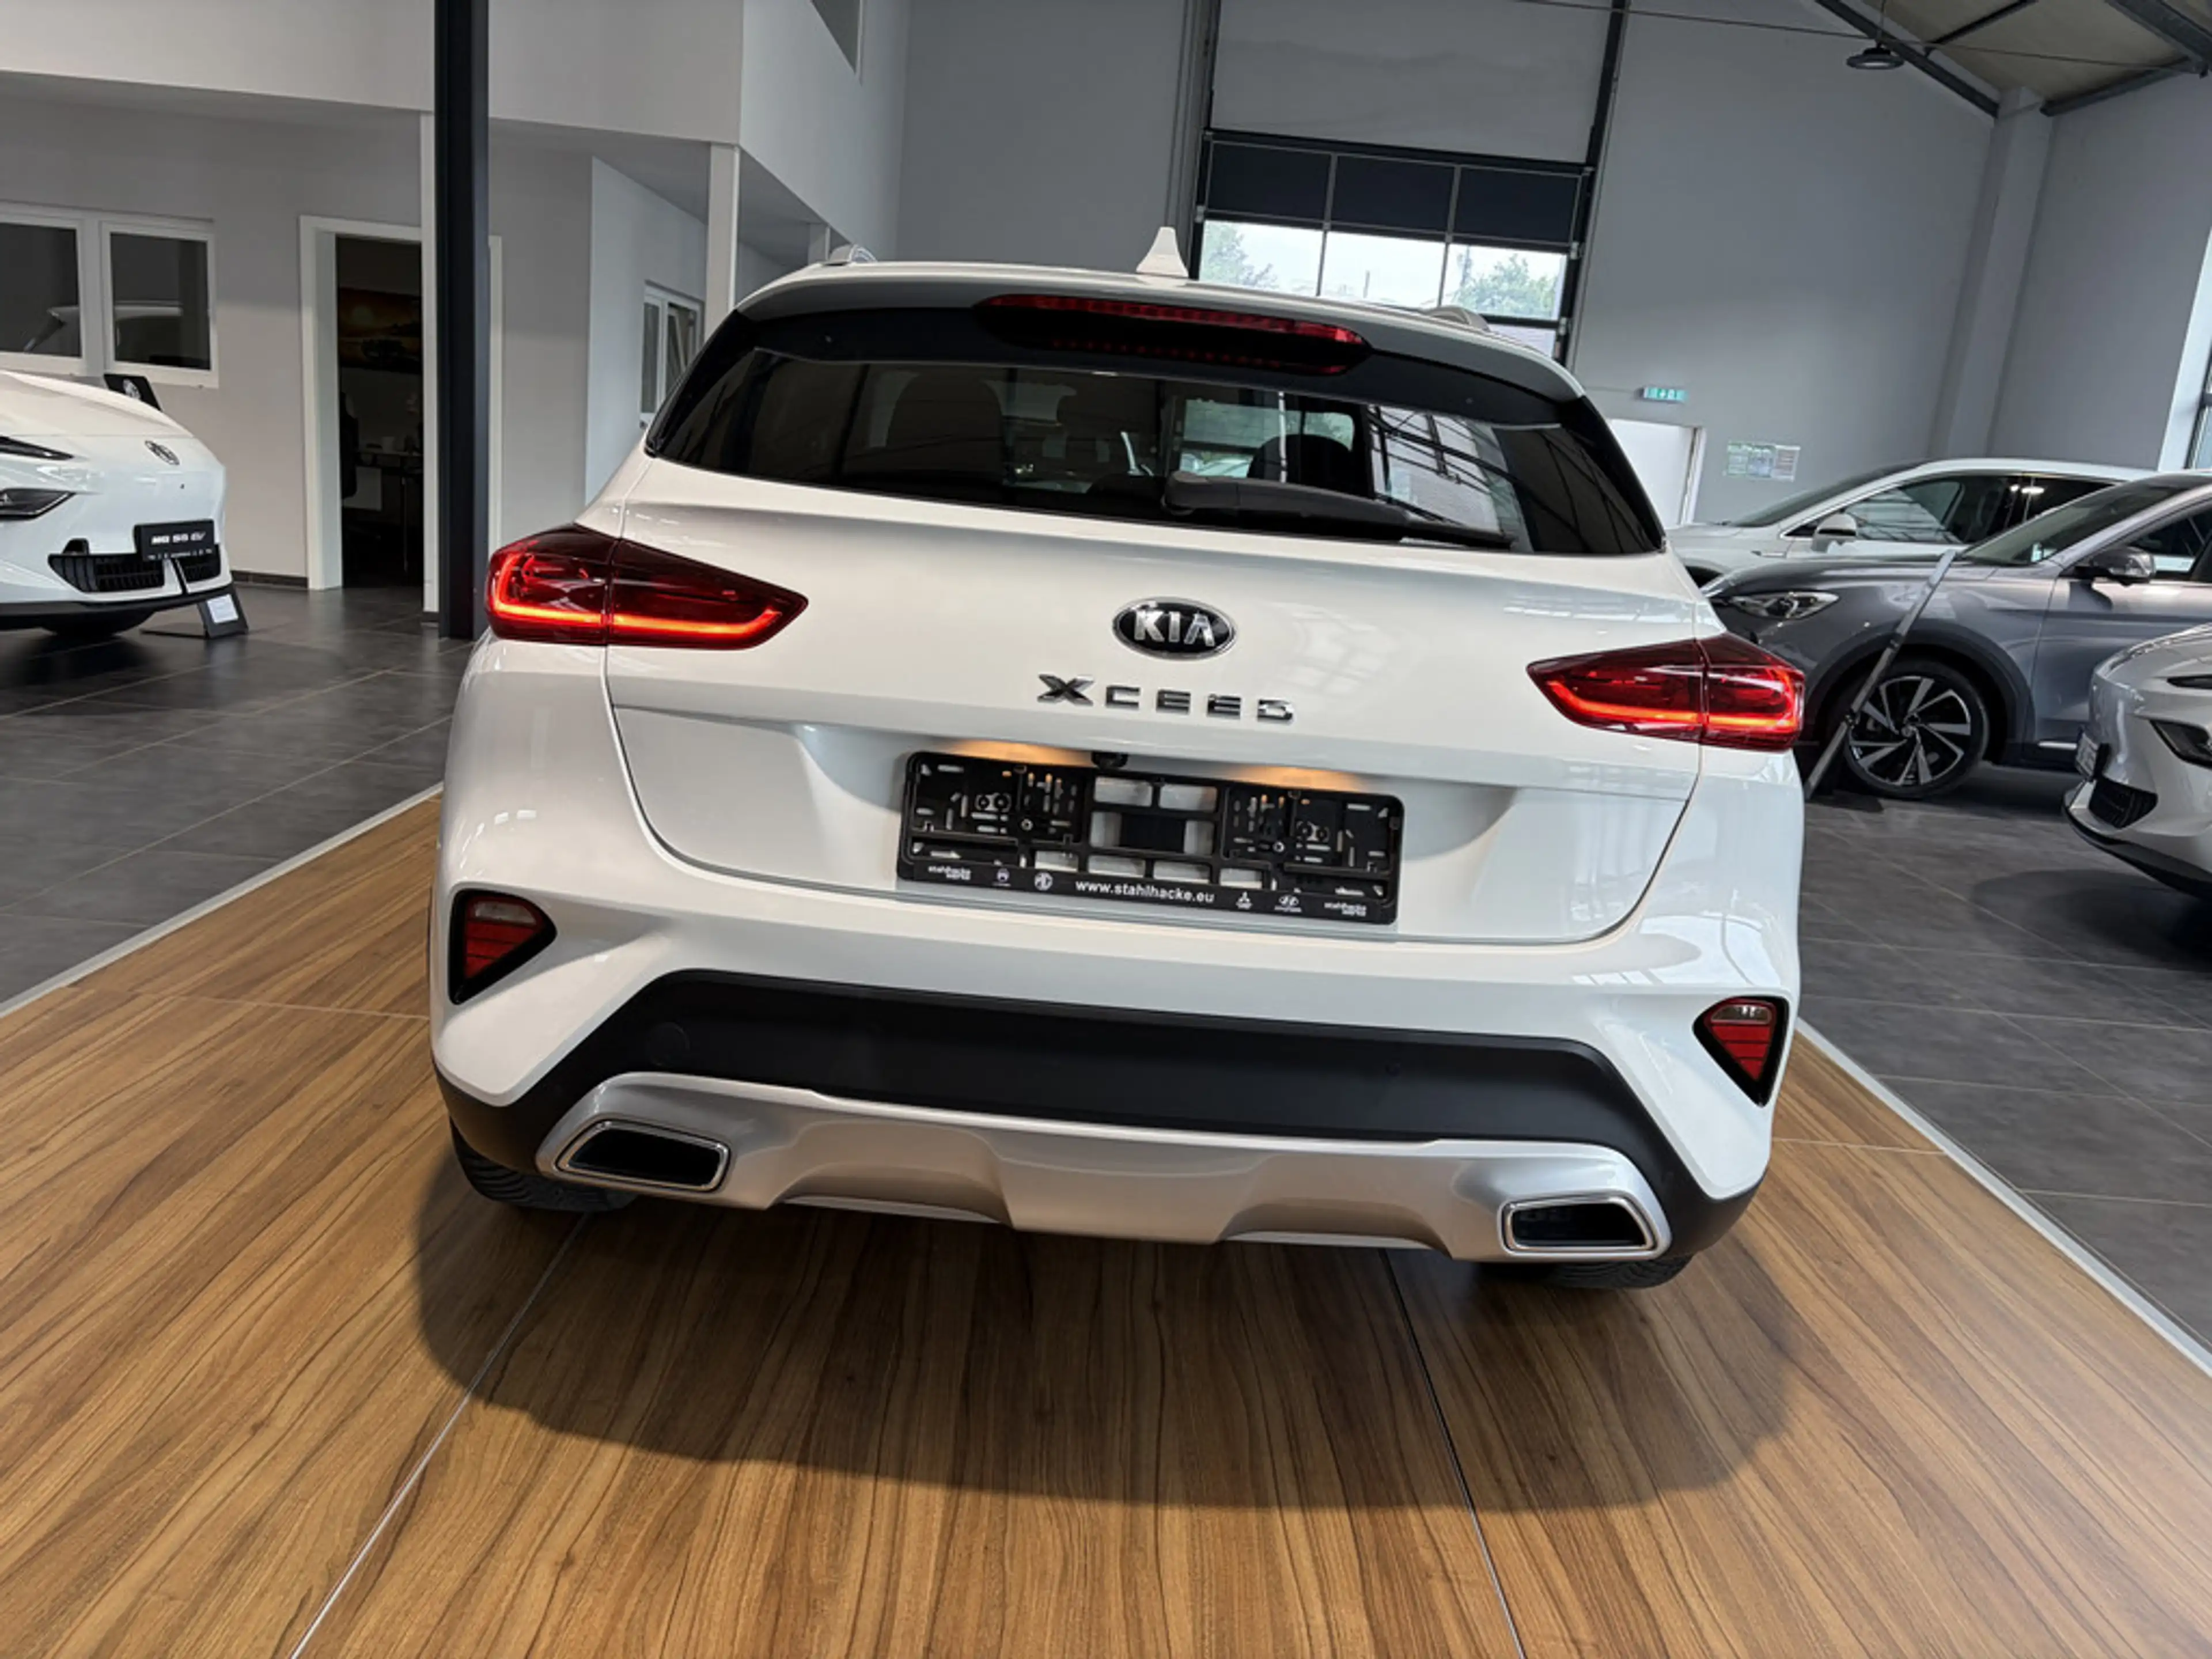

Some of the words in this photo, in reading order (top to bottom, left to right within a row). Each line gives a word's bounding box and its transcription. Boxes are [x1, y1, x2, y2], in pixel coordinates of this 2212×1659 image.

[1134, 609, 1215, 647] KIA
[1037, 673, 1296, 725] XCEED
[1075, 881, 1215, 903] www.stahlhacke.eu
